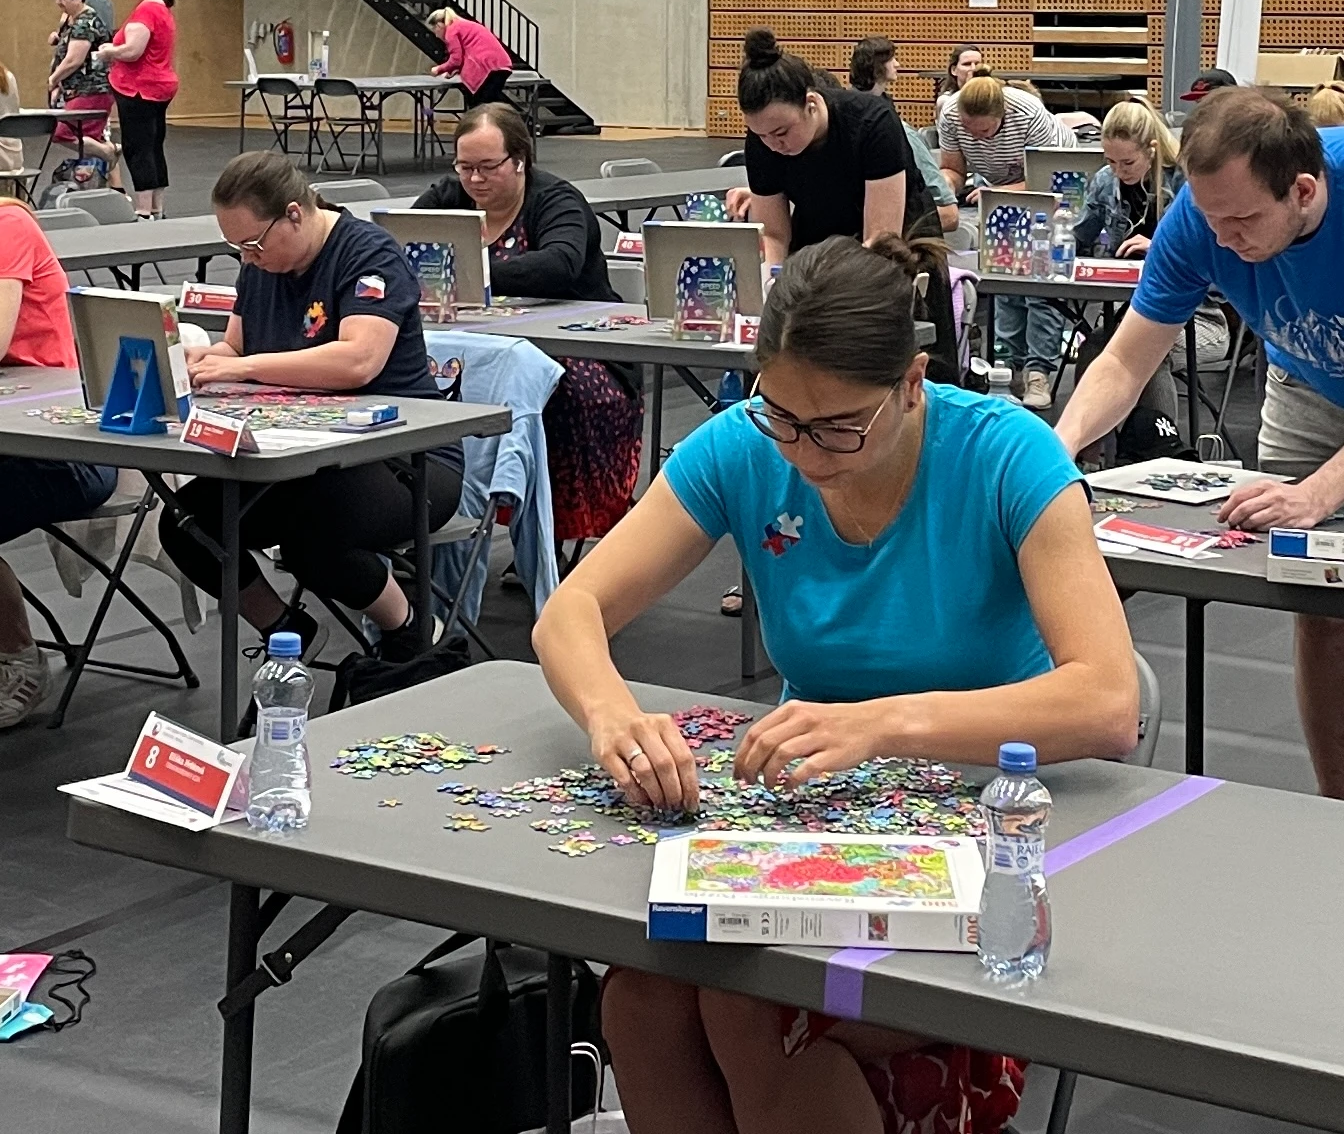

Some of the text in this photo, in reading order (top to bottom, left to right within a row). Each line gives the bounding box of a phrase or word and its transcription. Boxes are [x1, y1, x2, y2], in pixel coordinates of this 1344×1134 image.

[621, 240, 634, 249] 40
[1078, 267, 1094, 277] 39
[188, 293, 203, 304] 30
[189, 422, 202, 438] 19
[145, 745, 160, 769] 8
